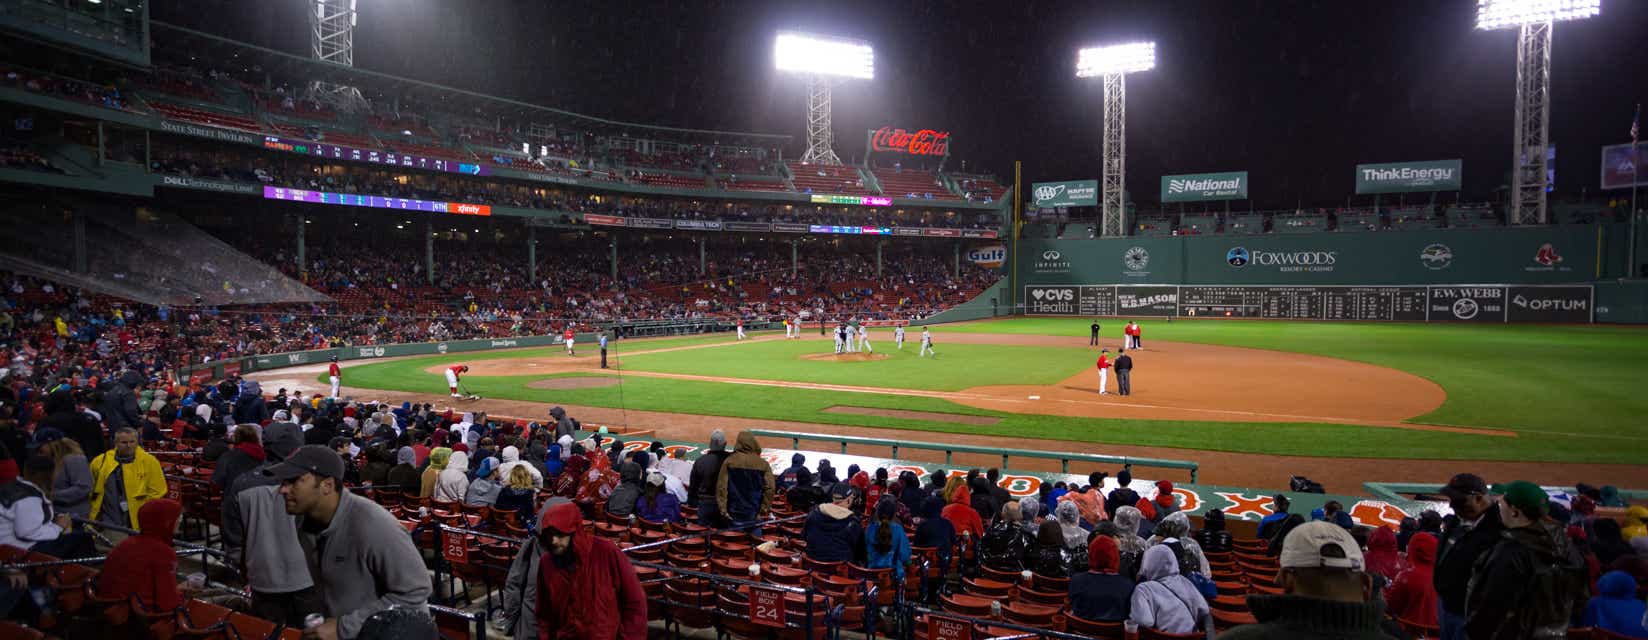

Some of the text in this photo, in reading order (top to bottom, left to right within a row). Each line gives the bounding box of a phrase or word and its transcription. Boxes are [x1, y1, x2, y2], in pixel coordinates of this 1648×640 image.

[161, 121, 252, 143] STATE STREET PAVILION
[164, 177, 187, 185] DELL
[1184, 178, 1240, 192] National
[458, 204, 480, 214] xfinity
[969, 250, 1003, 260] Gulf
[1252, 251, 1336, 265] FOXWOODS
[1045, 289, 1073, 300] CVS
[1433, 288, 1502, 298] F.W. WEBB
[1138, 294, 1177, 305] MASON
[1530, 299, 1586, 310] OPTUM
[1033, 301, 1073, 312] Health
[448, 545, 464, 557] 25
[755, 590, 778, 599] FIELD
[758, 597, 775, 605] BOX
[756, 605, 778, 620] 24
[936, 620, 963, 630] FIELD
[939, 628, 959, 637] BOX
